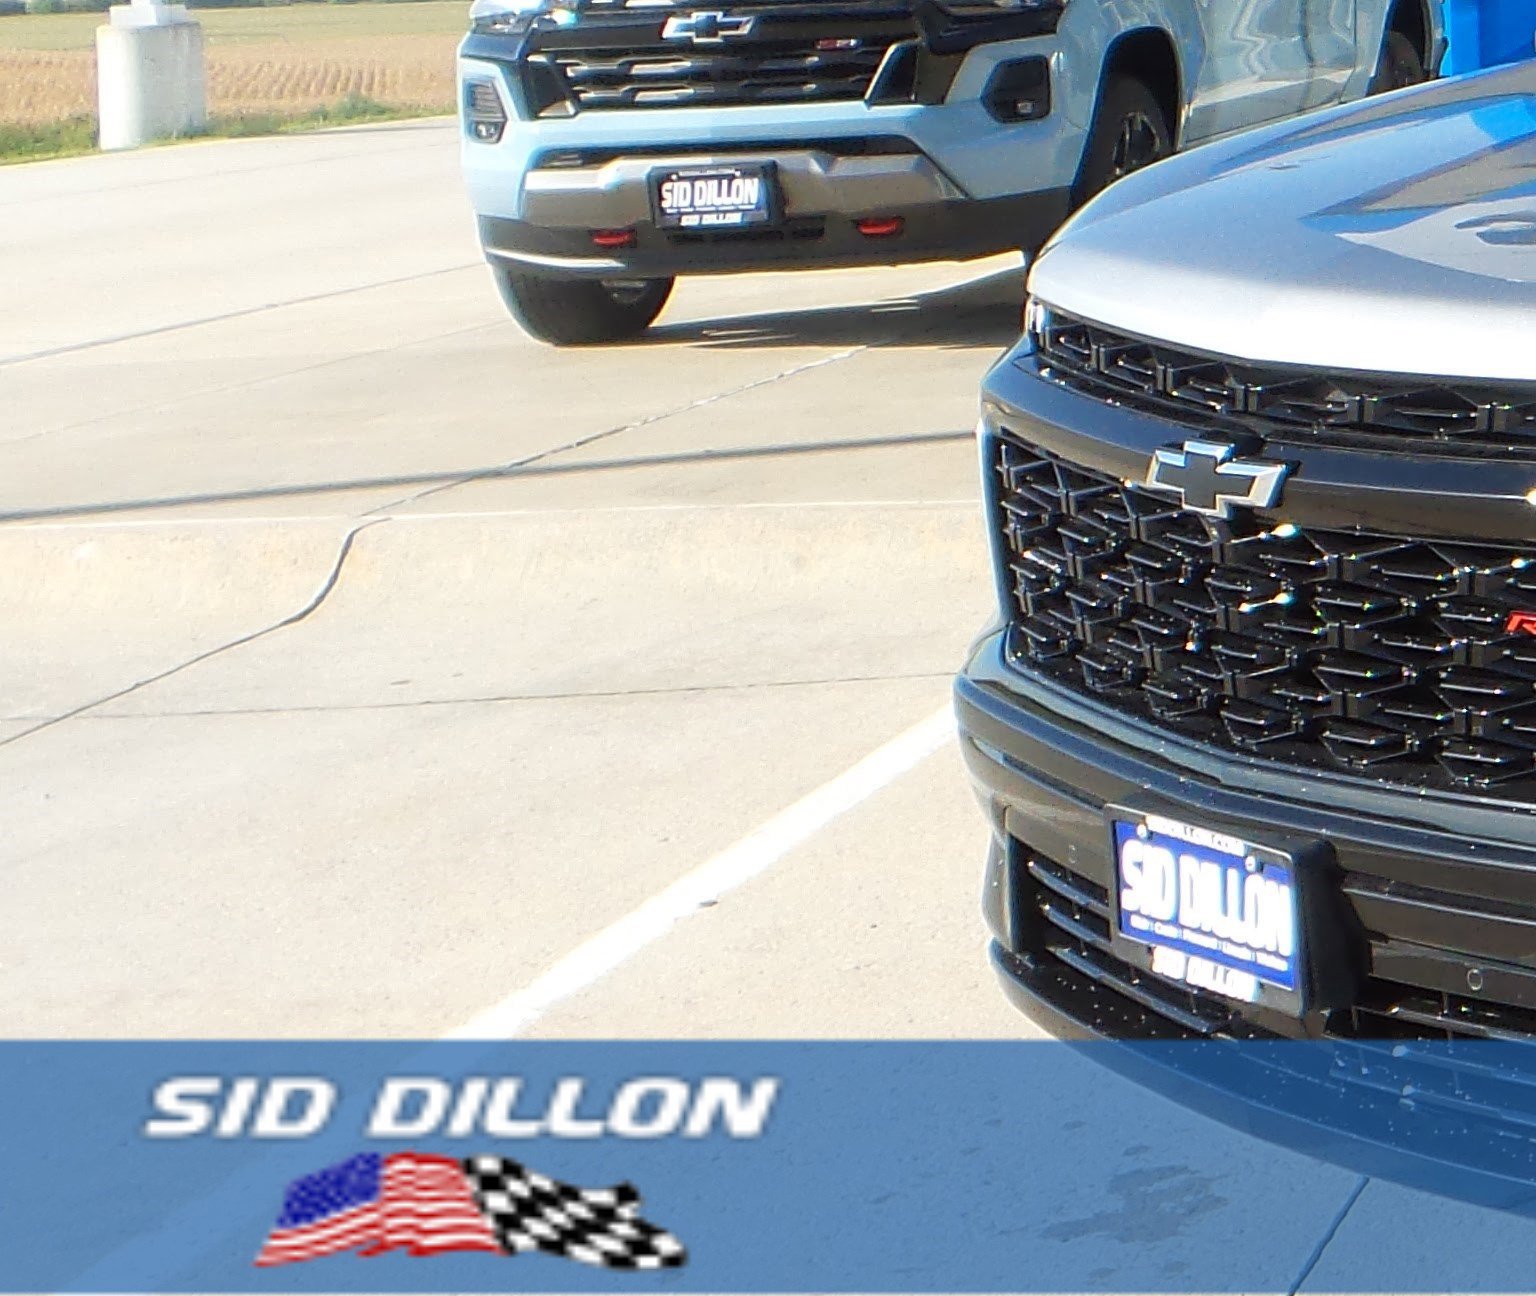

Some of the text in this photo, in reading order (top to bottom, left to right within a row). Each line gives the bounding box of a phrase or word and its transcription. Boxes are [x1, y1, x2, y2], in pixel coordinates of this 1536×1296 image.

[660, 177, 760, 209] SID DILLON
[1120, 839, 1177, 921] SID
[1178, 852, 1296, 957] DILLON
